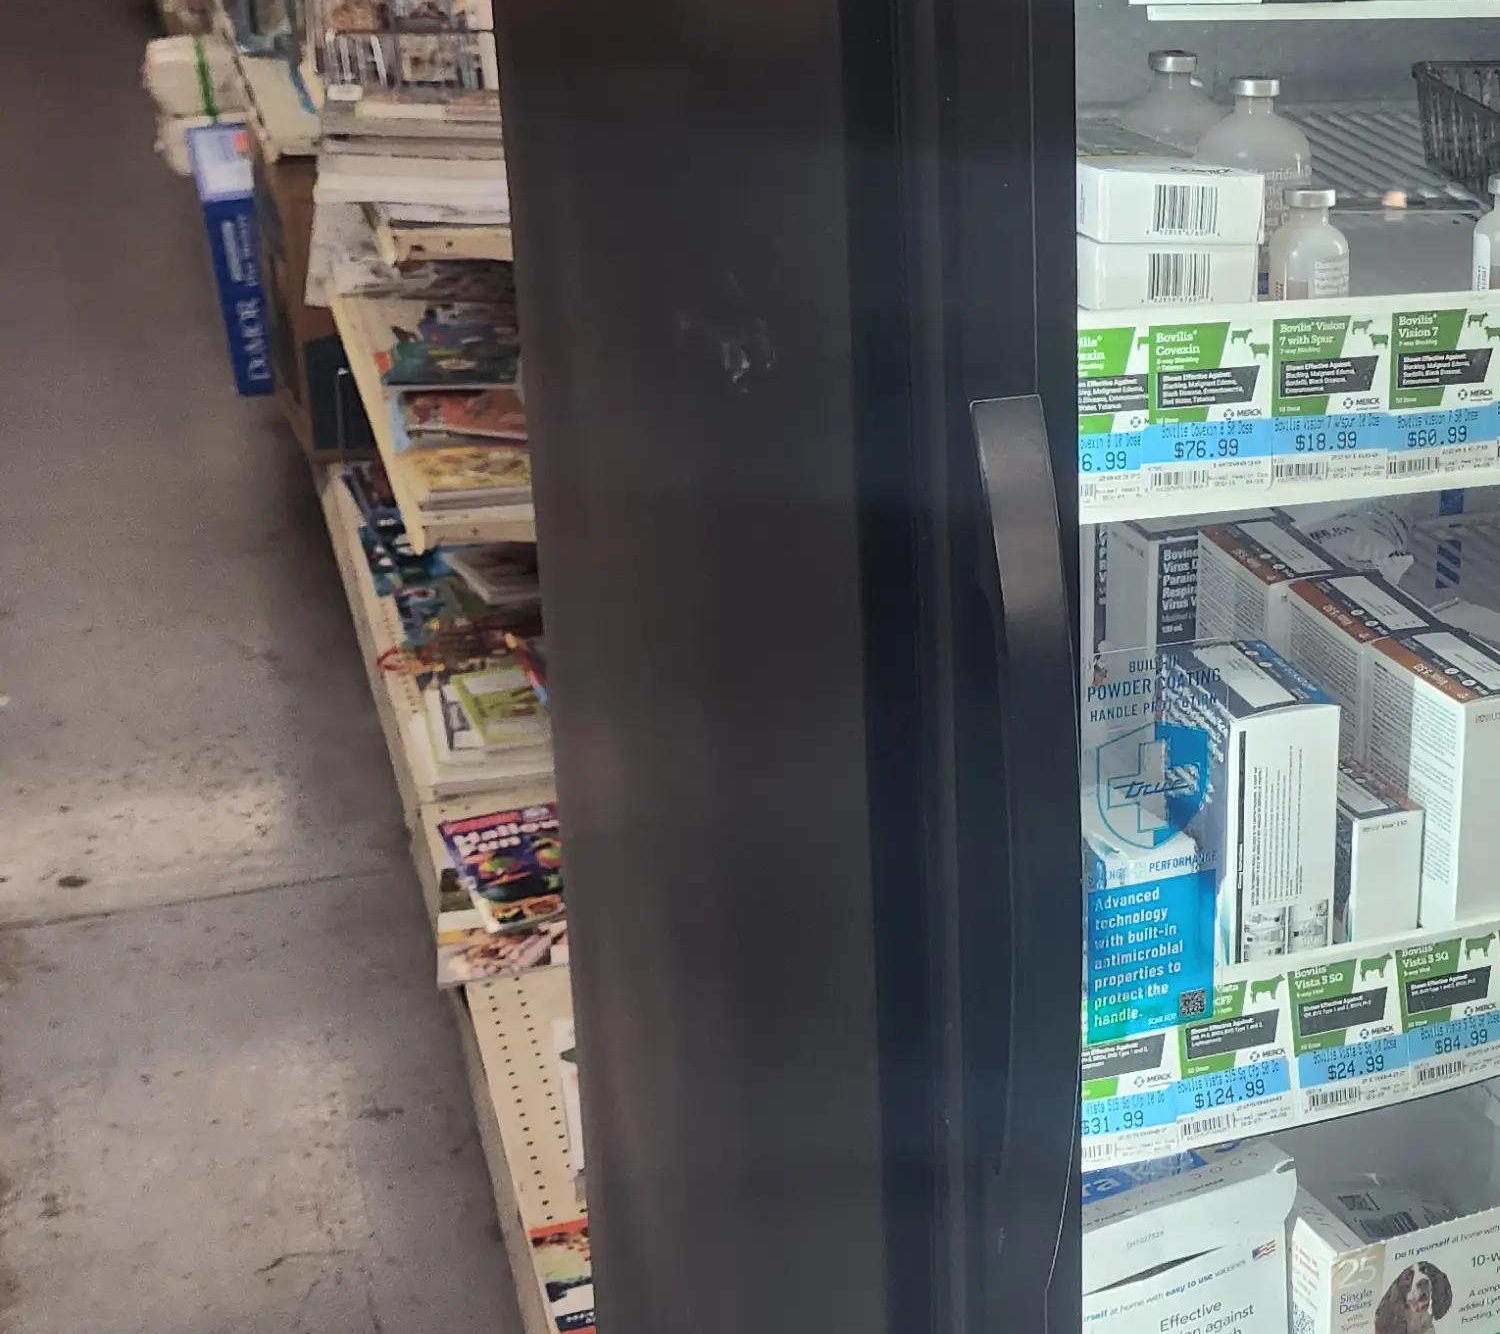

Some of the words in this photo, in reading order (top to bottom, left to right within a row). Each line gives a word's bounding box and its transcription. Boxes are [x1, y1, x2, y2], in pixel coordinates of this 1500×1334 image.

[1315, 321, 1345, 331] Vision
[1398, 328, 1429, 339] Vision
[1296, 431, 1357, 451] $18.99
[1408, 426, 1467, 447] $60.99
[1174, 438, 1238, 459] $76.99
[1088, 681, 1151, 701] POWDER
[1157, 668, 1221, 692] COATING
[1090, 704, 1138, 723] HANDLE
[1095, 887, 1160, 911] Advanced
[1095, 907, 1168, 930] technology
[1095, 931, 1123, 948] with
[1128, 925, 1176, 942] built-in
[1094, 941, 1183, 970] antimicrobial
[1402, 957, 1426, 968] Vista
[1094, 965, 1164, 991] properties
[1168, 961, 1181, 973] to
[1295, 977, 1319, 988] Vista
[1094, 988, 1144, 1010] protect
[1147, 983, 1169, 996] the
[1094, 1006, 1143, 1028] handle.
[1435, 1029, 1488, 1054] $84.99
[1328, 1055, 1384, 1080] $24.99
[1194, 1079, 1265, 1109] $124.99
[1338, 1255, 1377, 1289] 25
[1159, 1300, 1222, 1332] Effective
[1206, 1304, 1254, 1334] against
